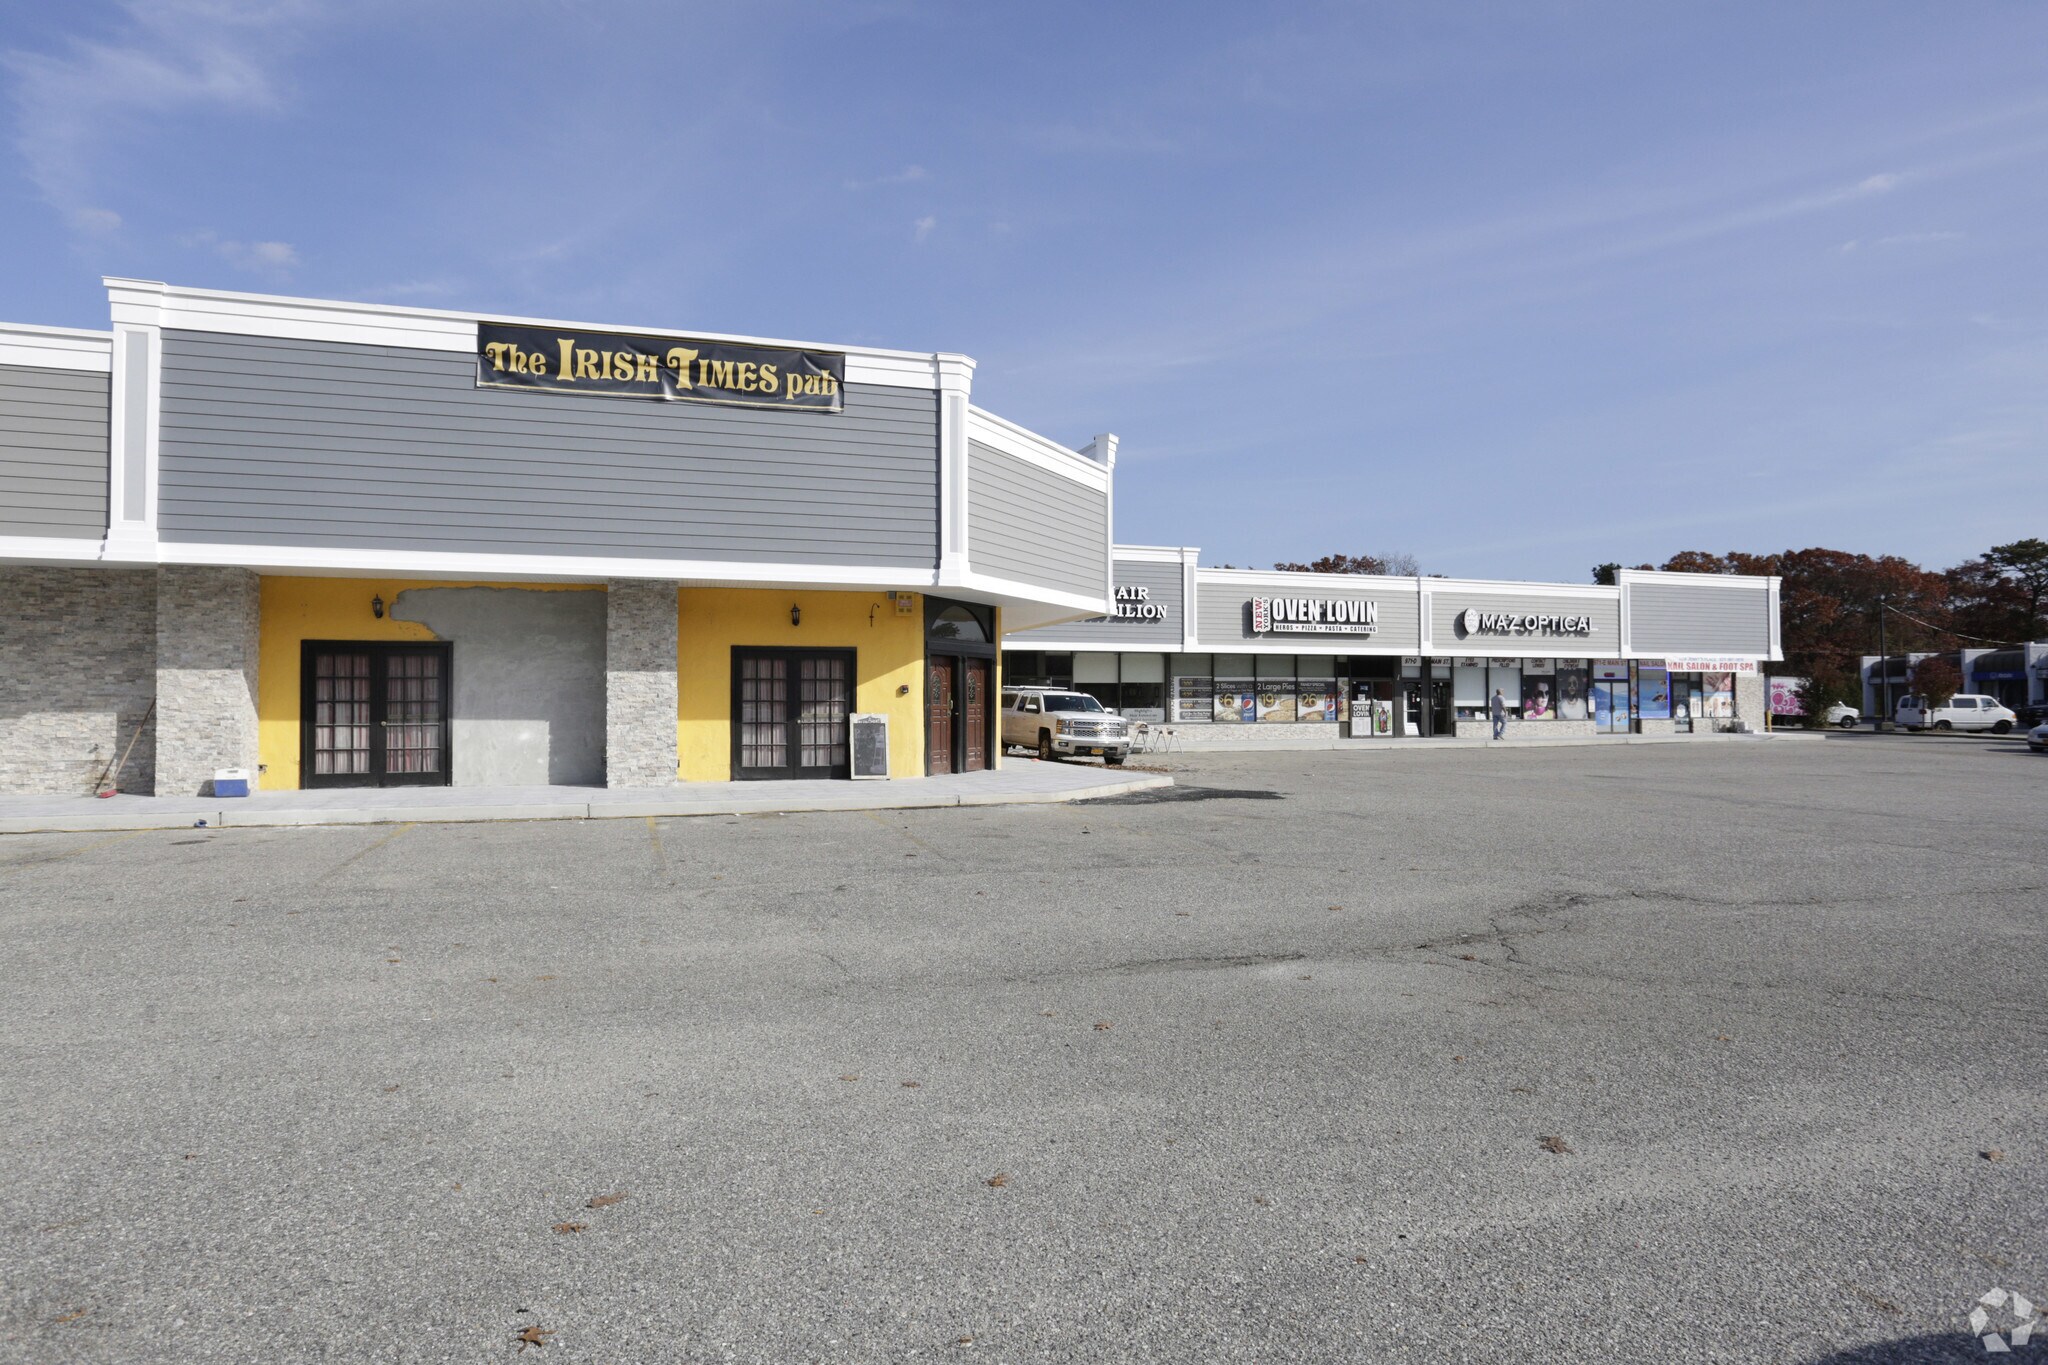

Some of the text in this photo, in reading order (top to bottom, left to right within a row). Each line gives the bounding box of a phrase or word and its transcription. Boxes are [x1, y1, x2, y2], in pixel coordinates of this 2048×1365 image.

[485, 337, 837, 400] The IRISH TIMES pub
[1113, 585, 1150, 600] AIR
[1117, 603, 1168, 618] ILION
[1255, 598, 1263, 630] NEW
[1272, 598, 1378, 623] OVEN LOVIN
[1481, 613, 1520, 630] MAZ
[1524, 615, 1600, 633] OPTICAL
[1686, 662, 1710, 671] SALON
[1719, 662, 1738, 670] FOOT
[1740, 662, 1754, 671] SPA
[1262, 683, 1281, 691] Large
